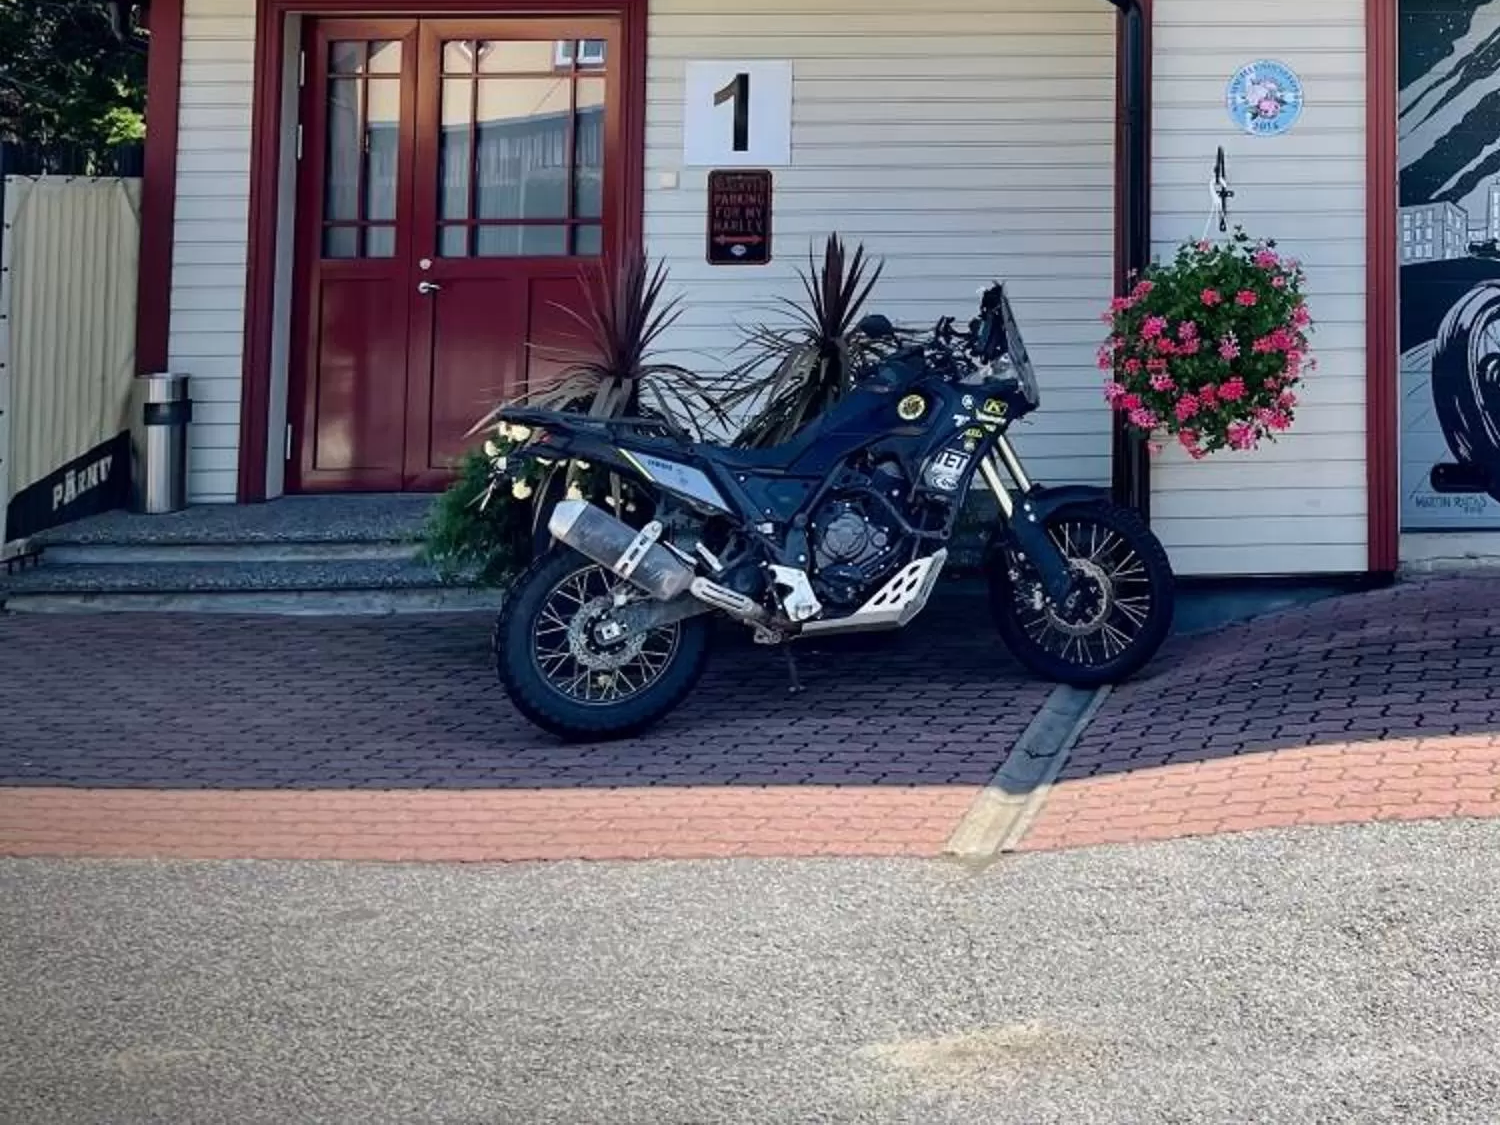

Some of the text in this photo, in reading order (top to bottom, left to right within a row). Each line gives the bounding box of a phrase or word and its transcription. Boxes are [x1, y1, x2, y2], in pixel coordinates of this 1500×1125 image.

[713, 73, 750, 152] 1
[714, 194, 765, 206] PARKING
[715, 207, 763, 219] FOR MY
